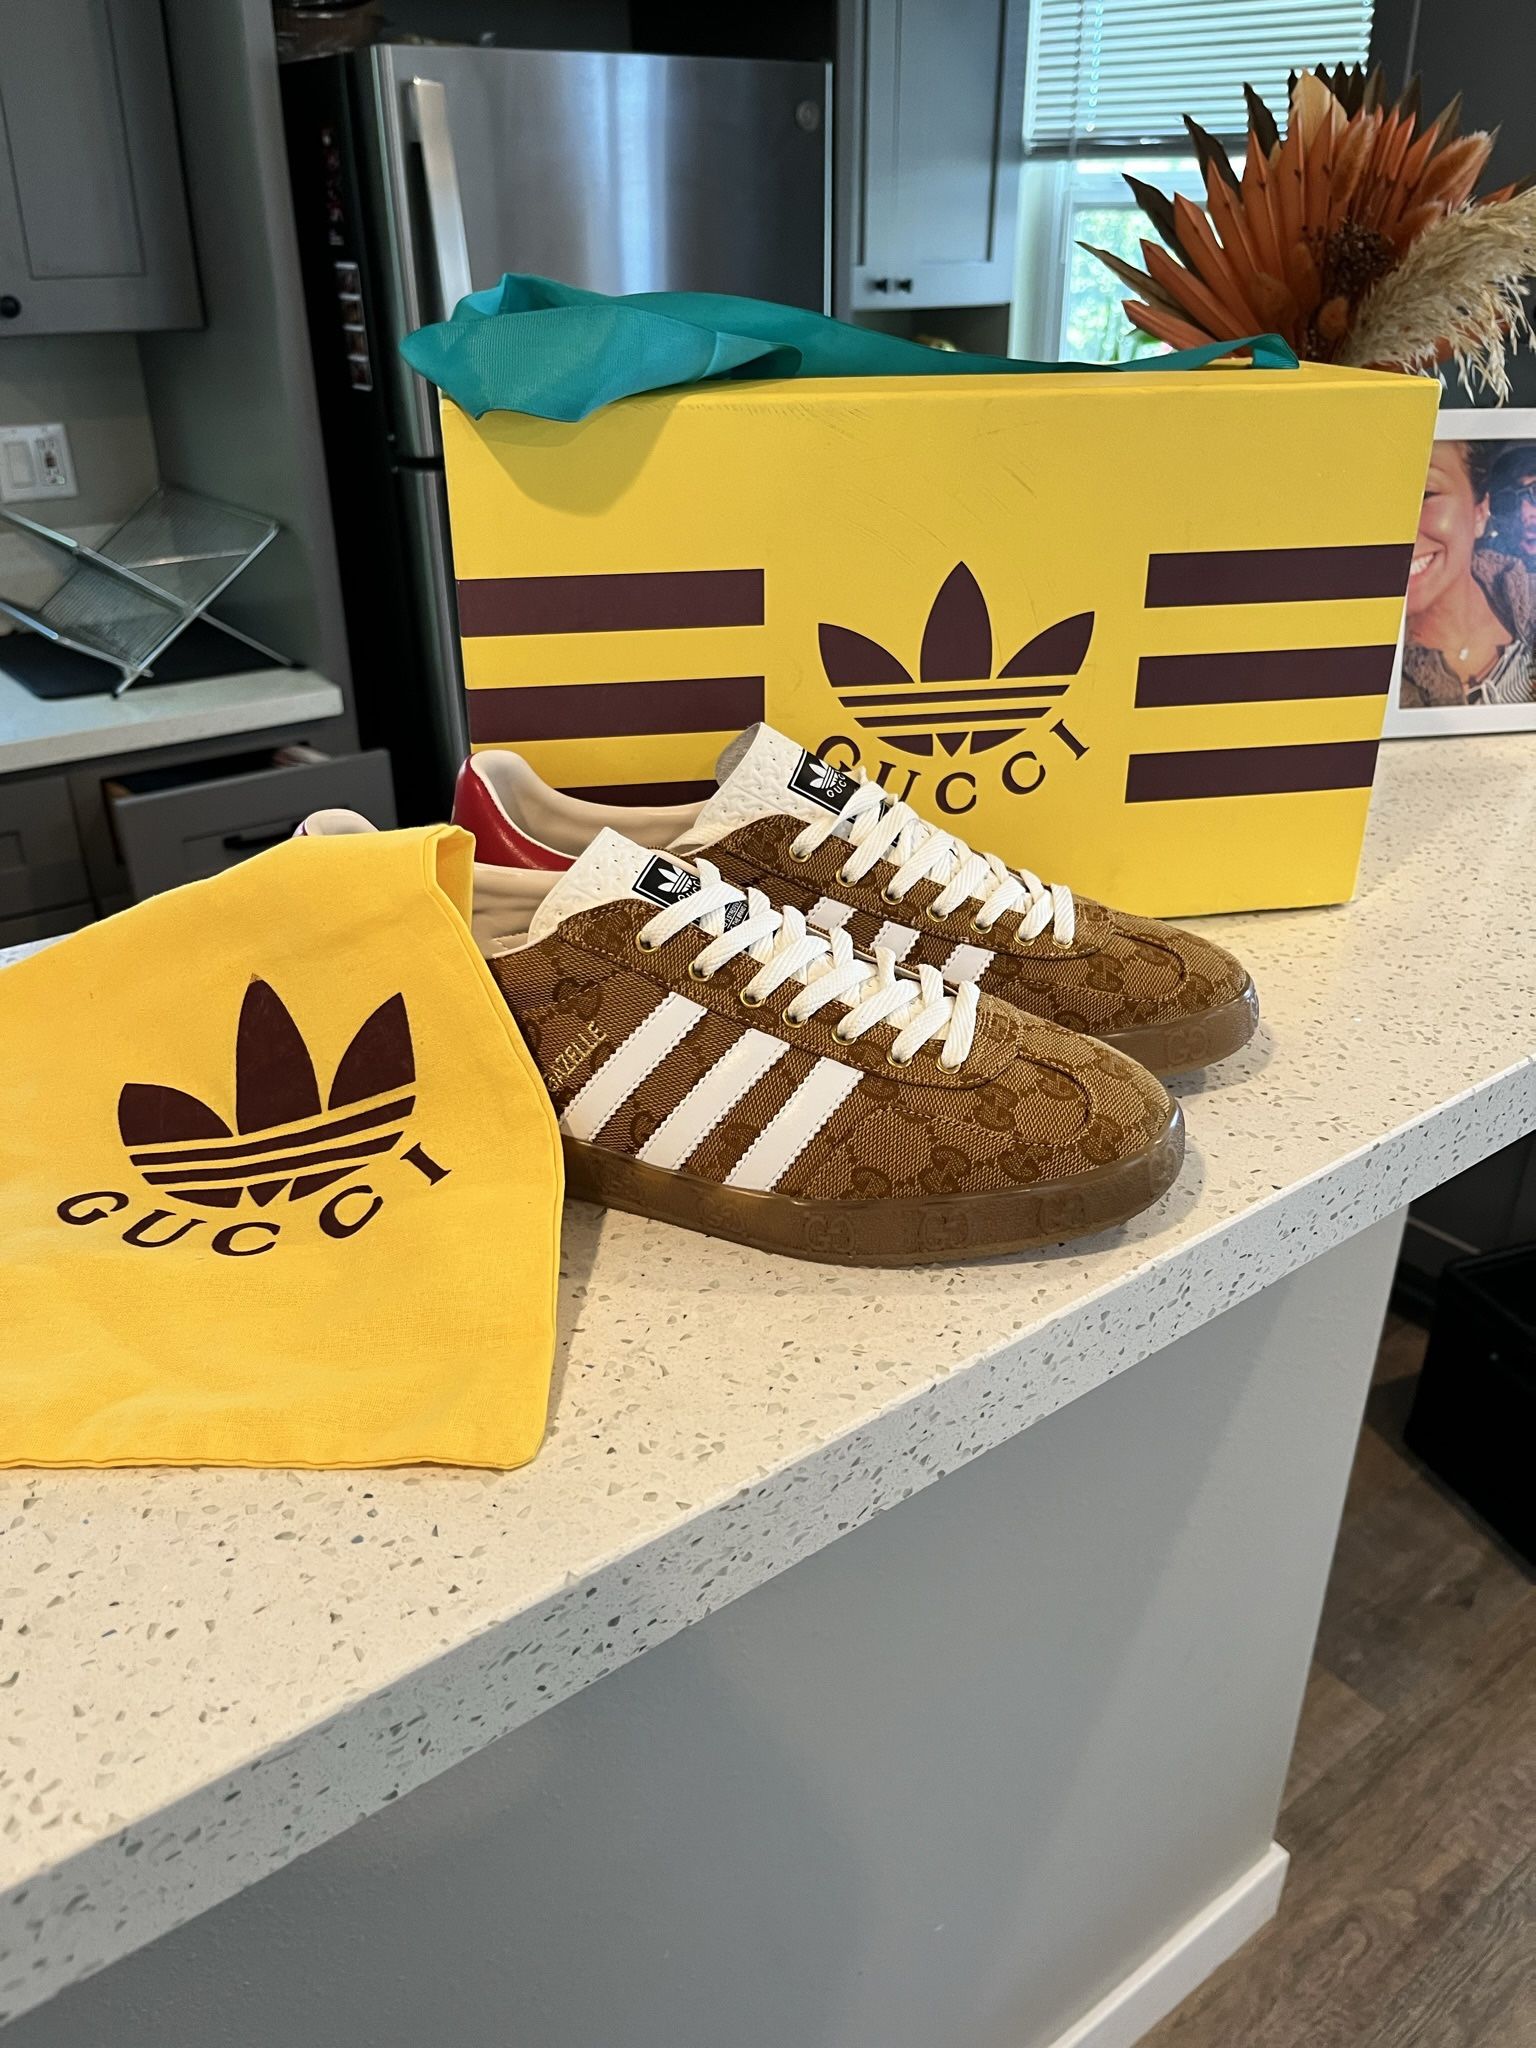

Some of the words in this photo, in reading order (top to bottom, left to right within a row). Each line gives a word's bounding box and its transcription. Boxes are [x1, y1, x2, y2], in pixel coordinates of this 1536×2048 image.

[815, 719, 1090, 814] GUCCI
[826, 773, 847, 798] GUCC
[57, 1142, 452, 1256] GUCCI
